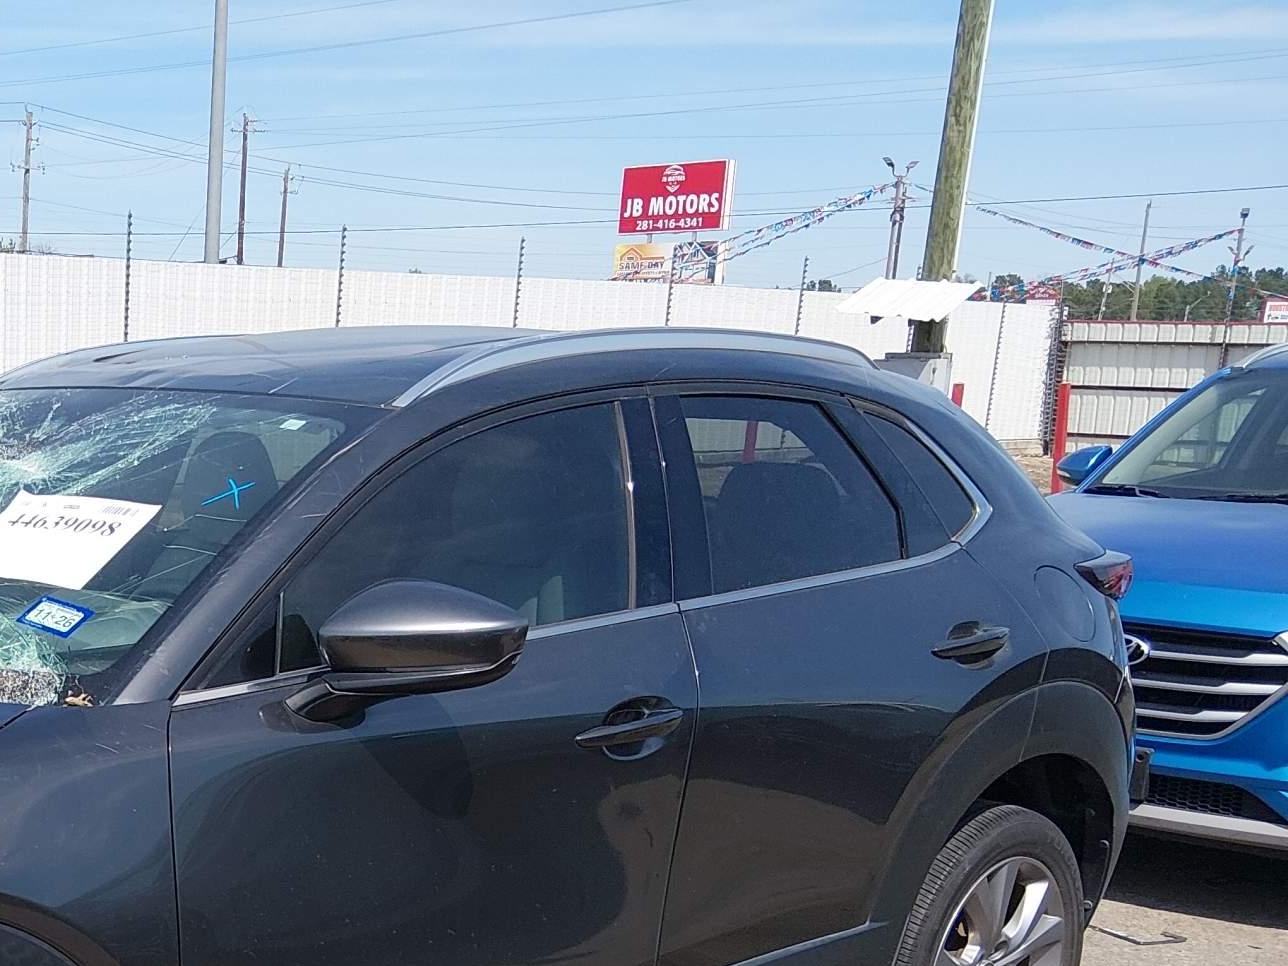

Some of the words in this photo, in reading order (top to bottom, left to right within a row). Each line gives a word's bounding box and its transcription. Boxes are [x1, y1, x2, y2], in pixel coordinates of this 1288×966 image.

[623, 198, 643, 217] JB
[648, 193, 720, 216] MOTORS
[635, 217, 703, 230] 281-416-4341
[8, 513, 122, 537] 44639098
[55, 615, 75, 628] 26
